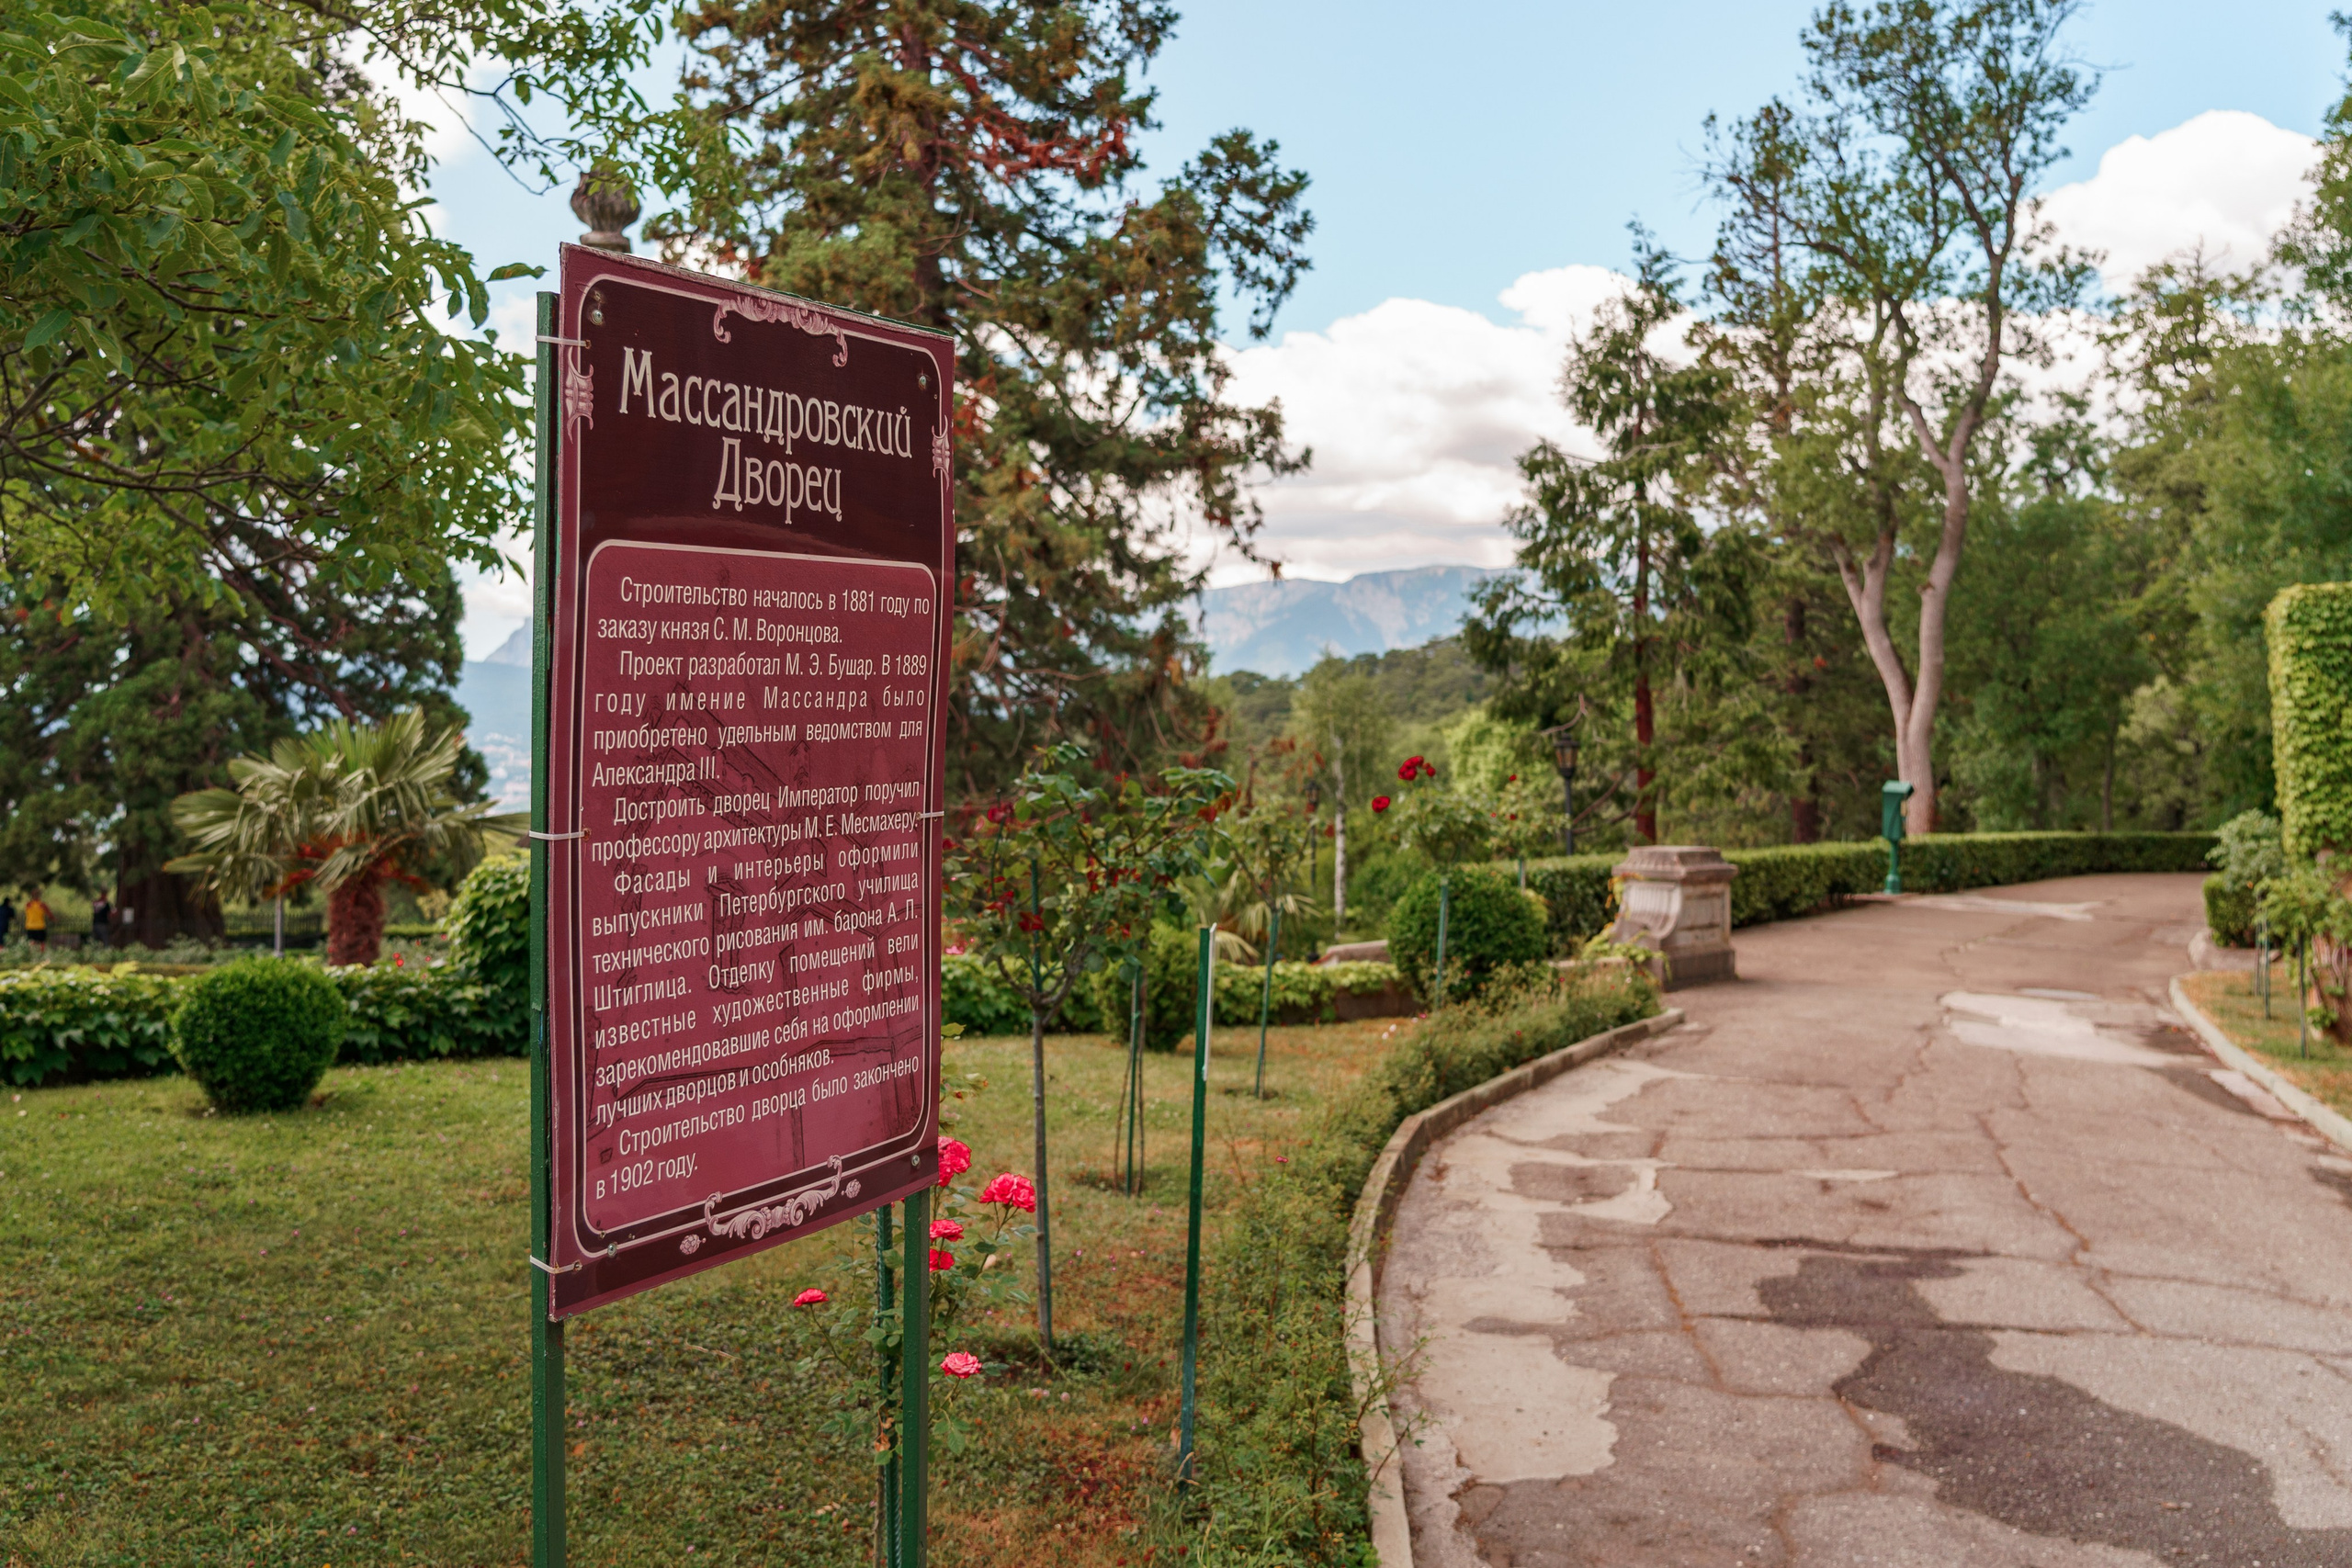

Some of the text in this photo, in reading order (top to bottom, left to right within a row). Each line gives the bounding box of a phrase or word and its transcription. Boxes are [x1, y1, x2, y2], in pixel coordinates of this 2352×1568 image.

[618, 345, 913, 459] Массандровский
[712, 436, 842, 525] Дворец
[621, 576, 930, 618] Строительство началось в 1881 году по
[597, 616, 842, 647] заказу князя С. М. Воронцова.
[620, 650, 927, 681] Проект разработал М. Э. Бушар. В 1889
[595, 685, 925, 717] году имение Массандра было
[594, 720, 922, 755] приобретено удельным ведомством для
[592, 761, 695, 787] Александра
[614, 781, 920, 826] Достроить дворец Император поручил
[592, 811, 918, 866] профессору архитектуры М. Е. Месмахеру.
[614, 842, 919, 896] Фасады и интерьеры оформили
[593, 872, 919, 937] выпускники Петербургского училища
[593, 936, 709, 974] технического
[717, 922, 797, 957] рисования
[805, 919, 829, 938] им.
[834, 909, 882, 934] барона
[888, 901, 900, 923] А.
[594, 933, 919, 1012] Штиглица. Отделку помещений вели
[595, 964, 919, 1050] известные художественные фирмы,
[595, 994, 919, 1088] зарекомендовавшие себя на оформлении
[595, 1049, 834, 1128] лучших дворцов и особняков.
[619, 1055, 919, 1156] Строительство дворца было закончено
[596, 1153, 698, 1200] в 1902 году.
